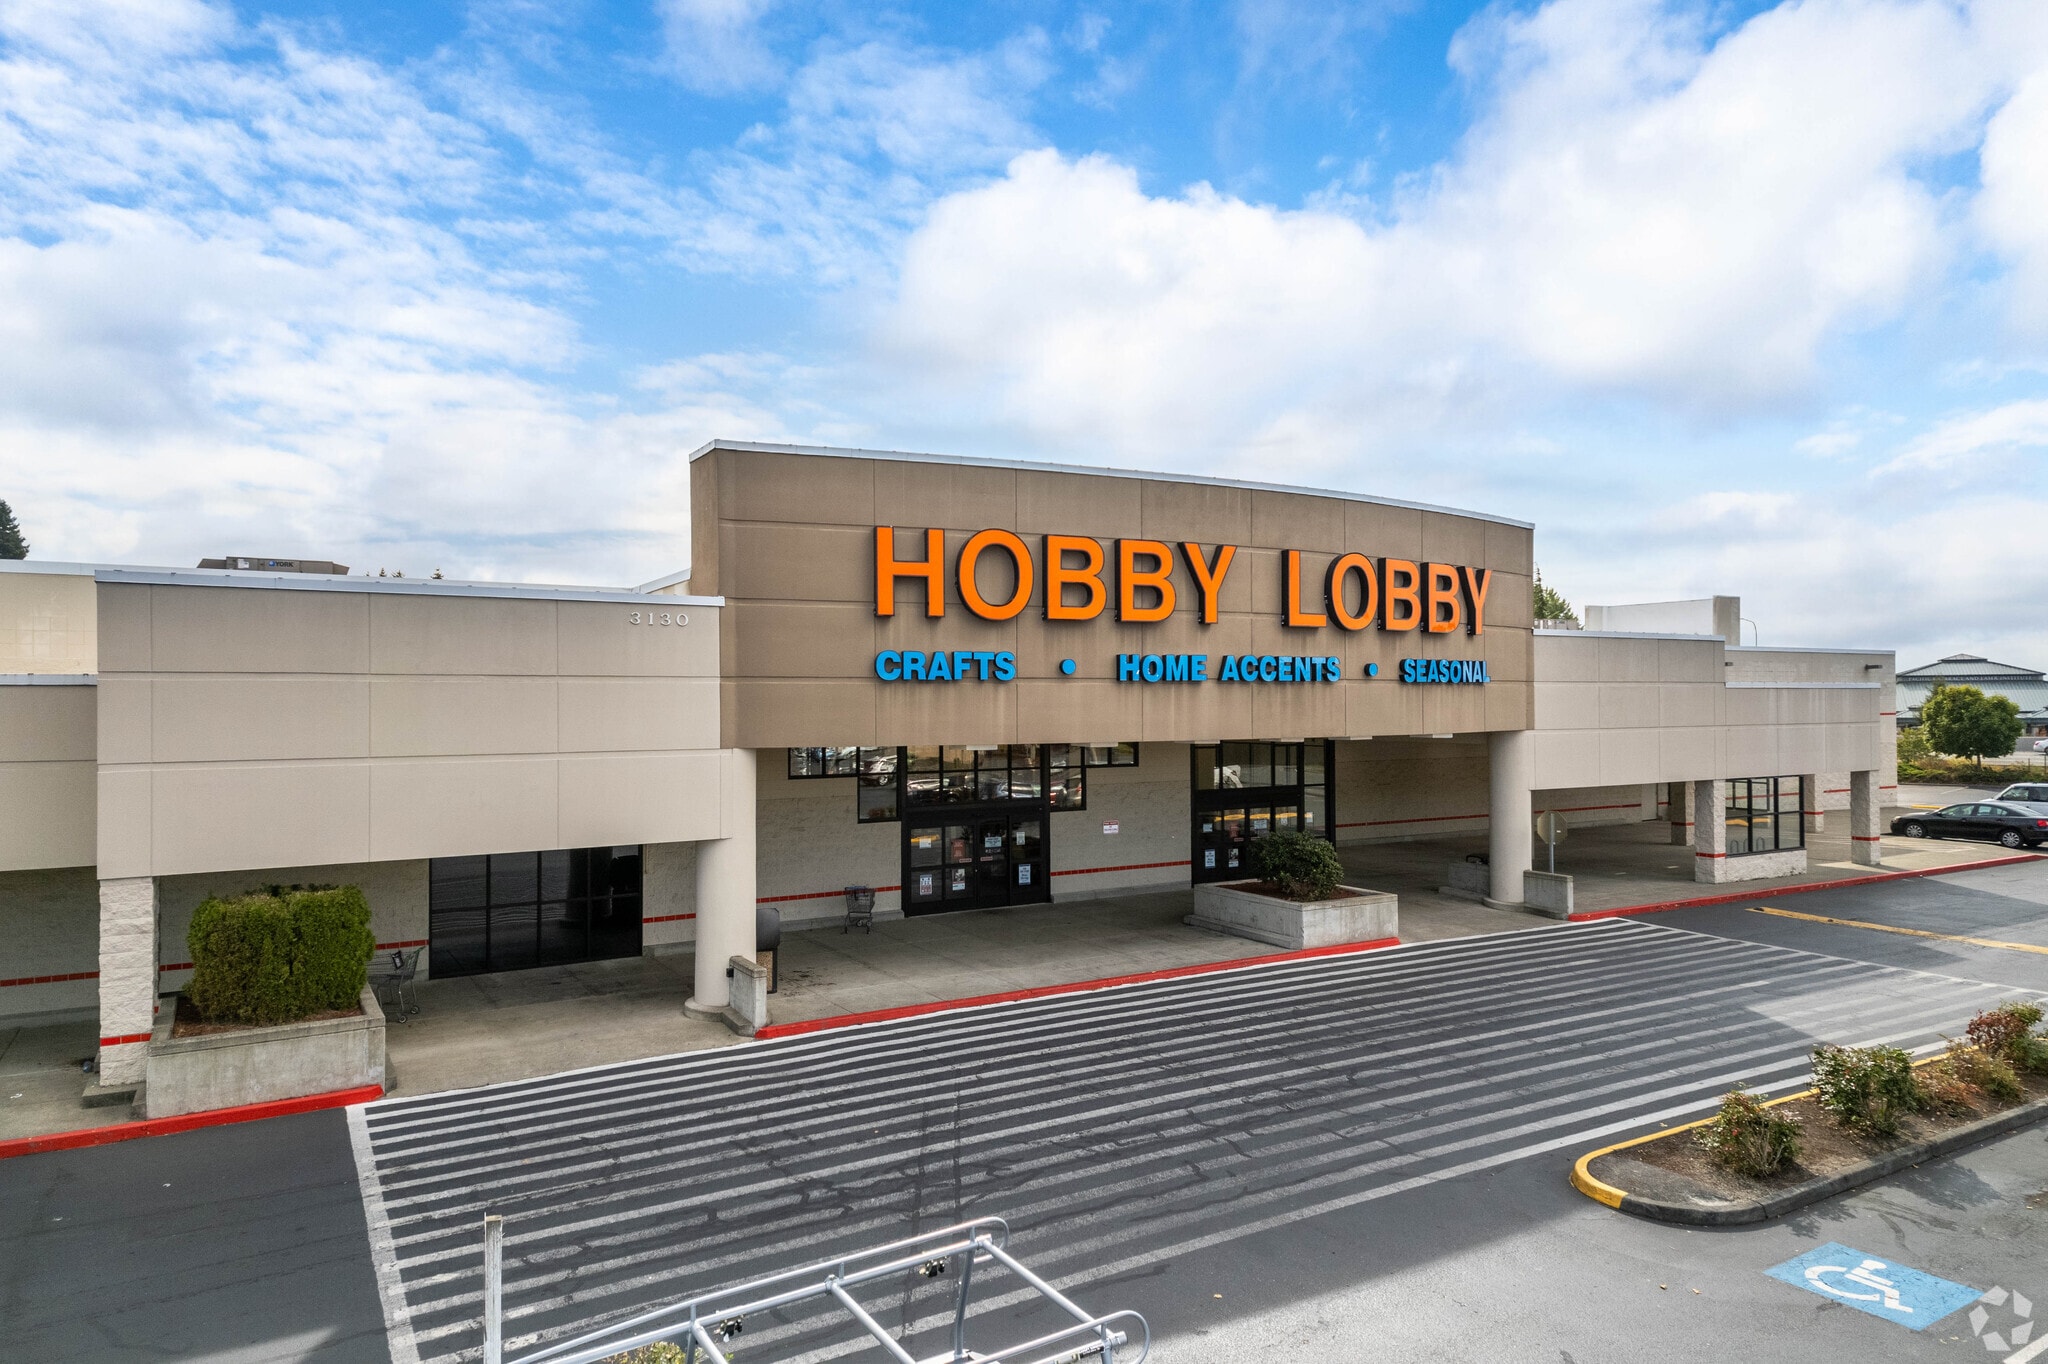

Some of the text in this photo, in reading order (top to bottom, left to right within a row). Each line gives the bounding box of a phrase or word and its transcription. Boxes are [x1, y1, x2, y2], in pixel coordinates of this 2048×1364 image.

[874, 525, 1492, 635] HOBBY LOBBY
[629, 611, 689, 626] 3130
[875, 650, 1491, 684] CRAFTS HOME ACCENTS SEASONAL
